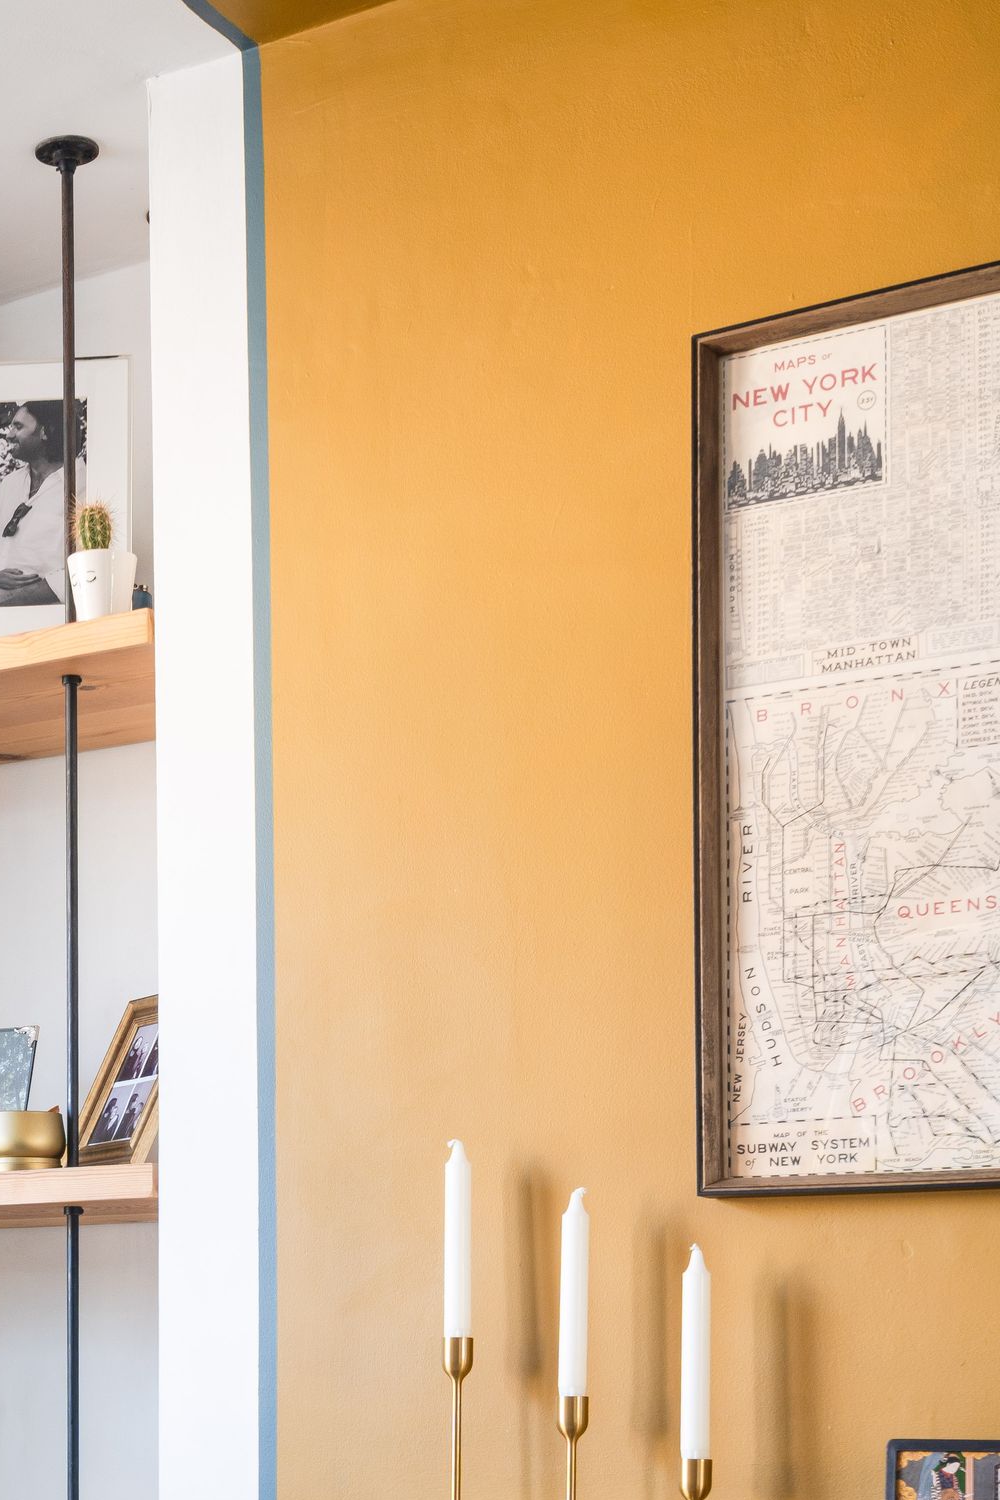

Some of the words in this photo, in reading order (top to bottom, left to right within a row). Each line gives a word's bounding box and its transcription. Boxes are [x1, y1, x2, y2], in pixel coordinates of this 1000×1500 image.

[774, 355, 816, 373] MAPS
[732, 382, 790, 411] NEW
[802, 362, 878, 395] YORK
[773, 398, 833, 428] CITY
[821, 650, 916, 673] MANHATTAN
[743, 824, 753, 902] RIVER
[834, 842, 857, 989] MANHATTAN
[896, 895, 1000, 919] QUEENS
[744, 967, 782, 1067] HUDSON
[735, 1012, 748, 1063] JERSEY
[732, 1073, 743, 1103] NEW
[737, 1141, 797, 1155] SUBWAY
[811, 1137, 870, 1150] SYSTEM
[745, 1157, 756, 1169] of
[769, 1156, 801, 1166] NEW
[817, 1153, 859, 1165] YORK
